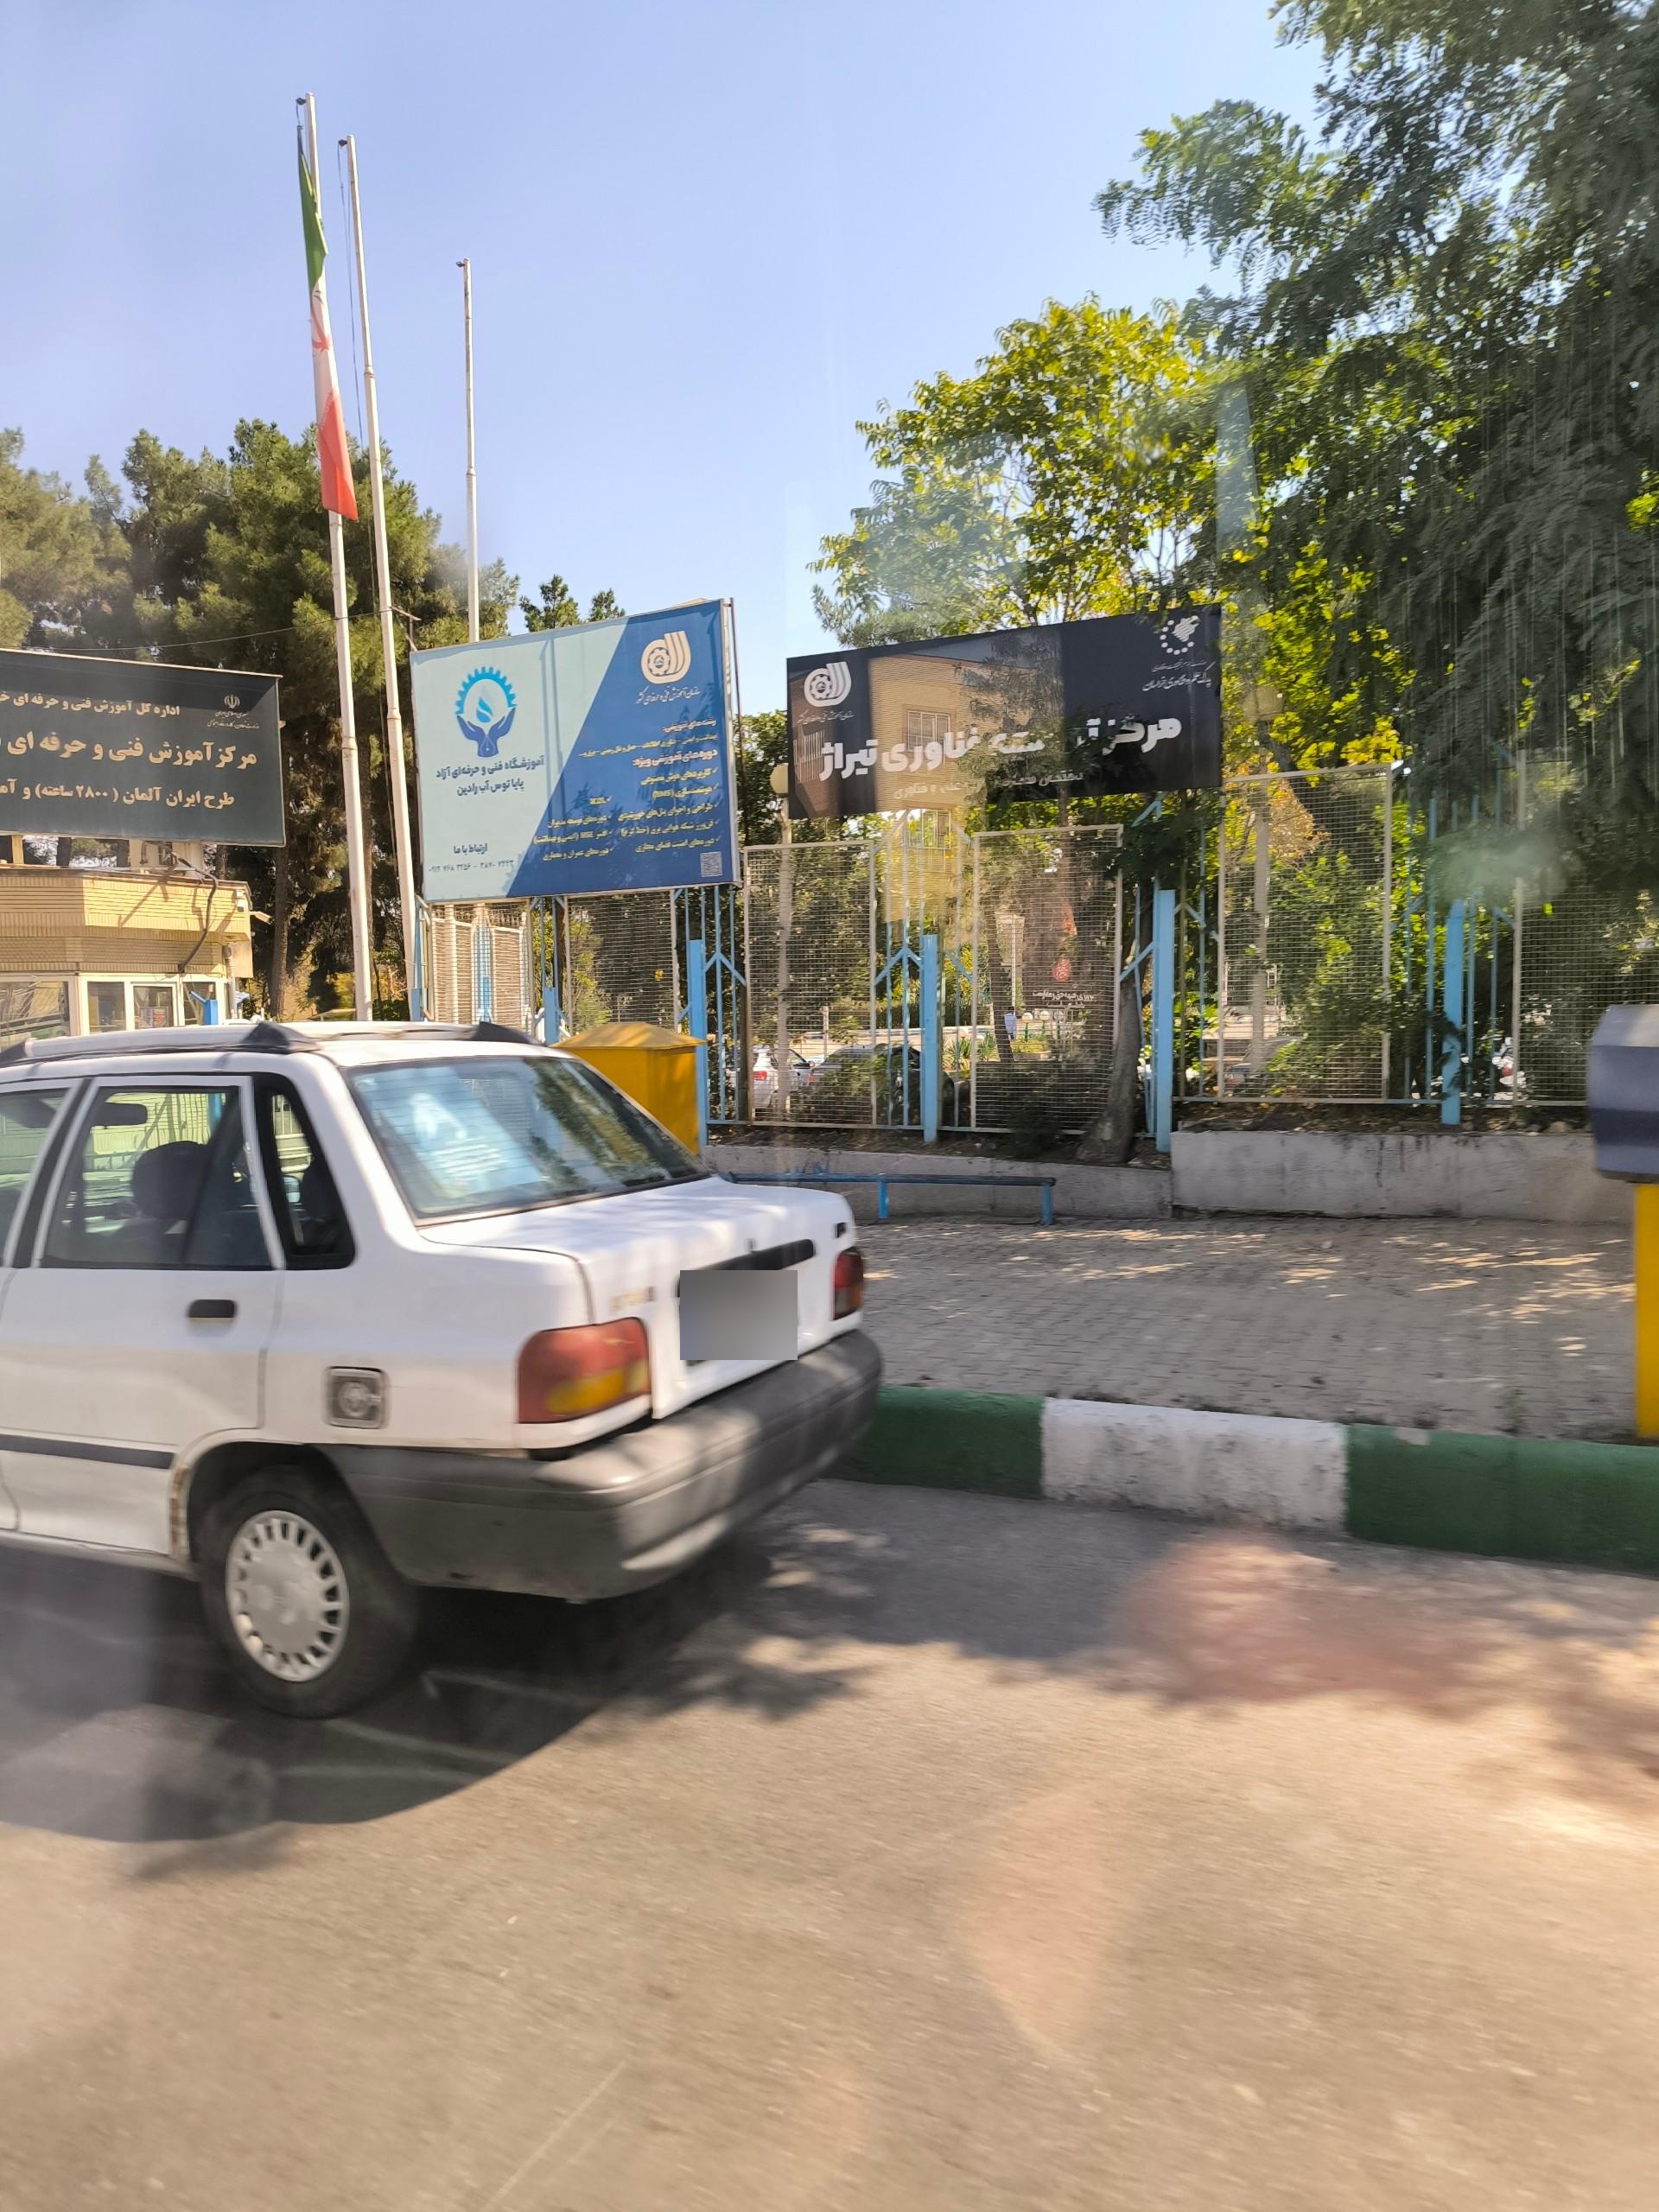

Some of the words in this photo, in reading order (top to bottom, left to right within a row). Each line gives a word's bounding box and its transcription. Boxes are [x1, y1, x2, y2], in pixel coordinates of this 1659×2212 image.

[13, 692, 29, 707] ای
[31, 693, 59, 709] حرفه
[62, 700, 69, 710] و
[71, 697, 92, 711] فنی
[94, 699, 133, 714] آموزش
[136, 702, 152, 715] کل
[154, 705, 181, 717] اداره
[7, 731, 34, 755] ای
[39, 732, 86, 759] حرفه
[109, 737, 143, 761] فنی
[92, 743, 104, 760] و
[149, 741, 213, 766] آموزش
[215, 746, 257, 769] مرکز
[505, 755, 544, 771] آموزشگاه
[819, 739, 878, 781] تیراژ
[435, 766, 450, 780] آزاد
[481, 767, 486, 776] و
[487, 761, 503, 775] فنی
[22, 785, 31, 800] و
[123, 786, 162, 805] آلمان
[166, 789, 200, 808] ایران
[203, 791, 234, 810] طرح
[453, 845, 460, 854] ما
[461, 844, 467, 855] با
[468, 843, 488, 855] ارتباط
